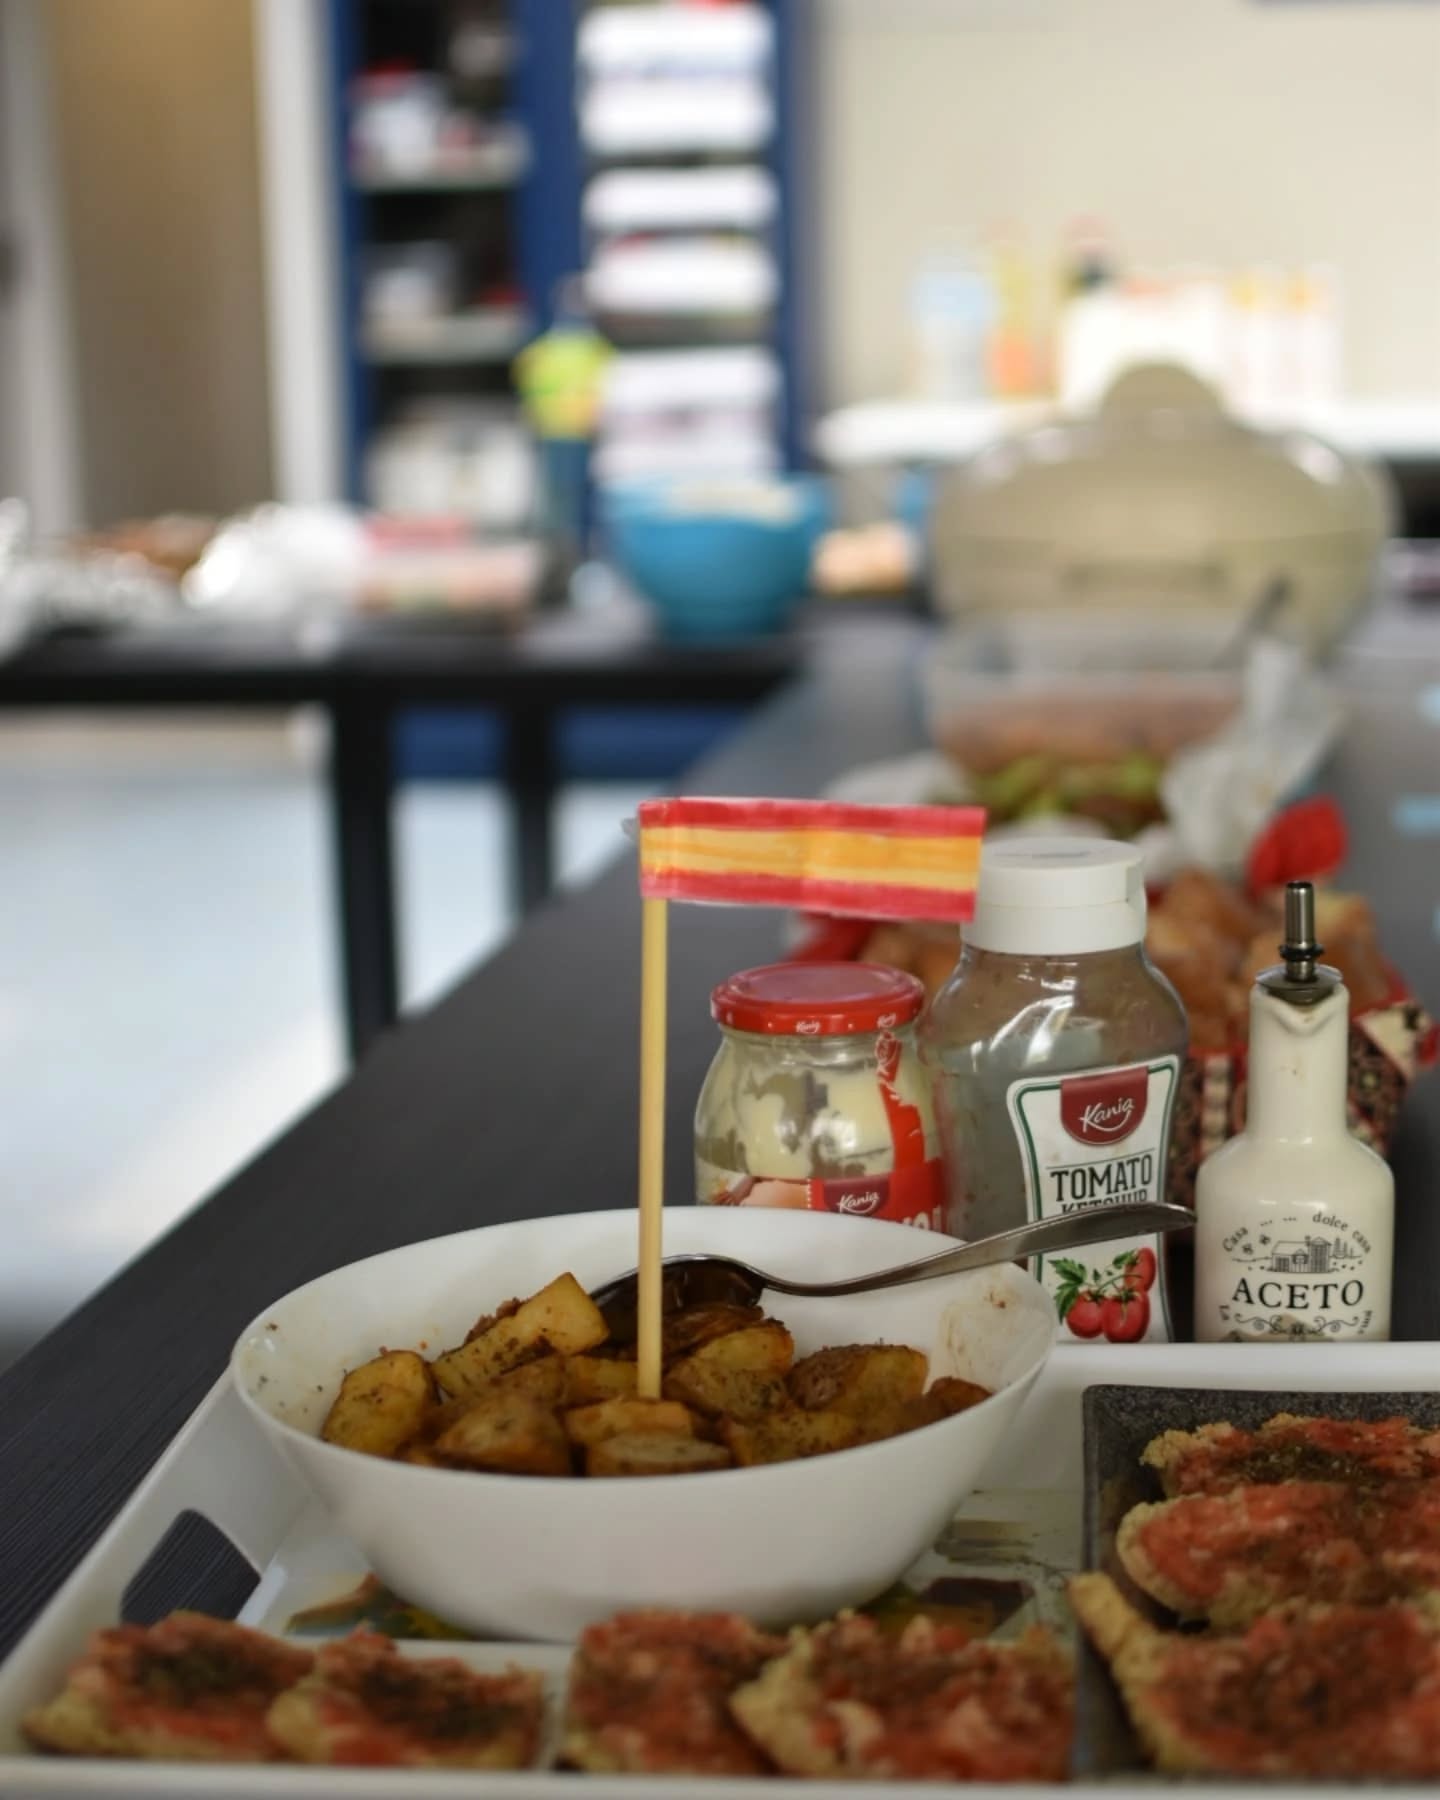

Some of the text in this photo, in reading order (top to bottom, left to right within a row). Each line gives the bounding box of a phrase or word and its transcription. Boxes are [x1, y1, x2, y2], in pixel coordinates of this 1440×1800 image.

[1079, 1096, 1136, 1133] Kania
[1050, 1154, 1153, 1202] TOMATO
[836, 1191, 880, 1214] Kania
[1312, 1211, 1349, 1231] dolce
[1352, 1229, 1372, 1253] casa
[1231, 1277, 1364, 1309] ACETO
